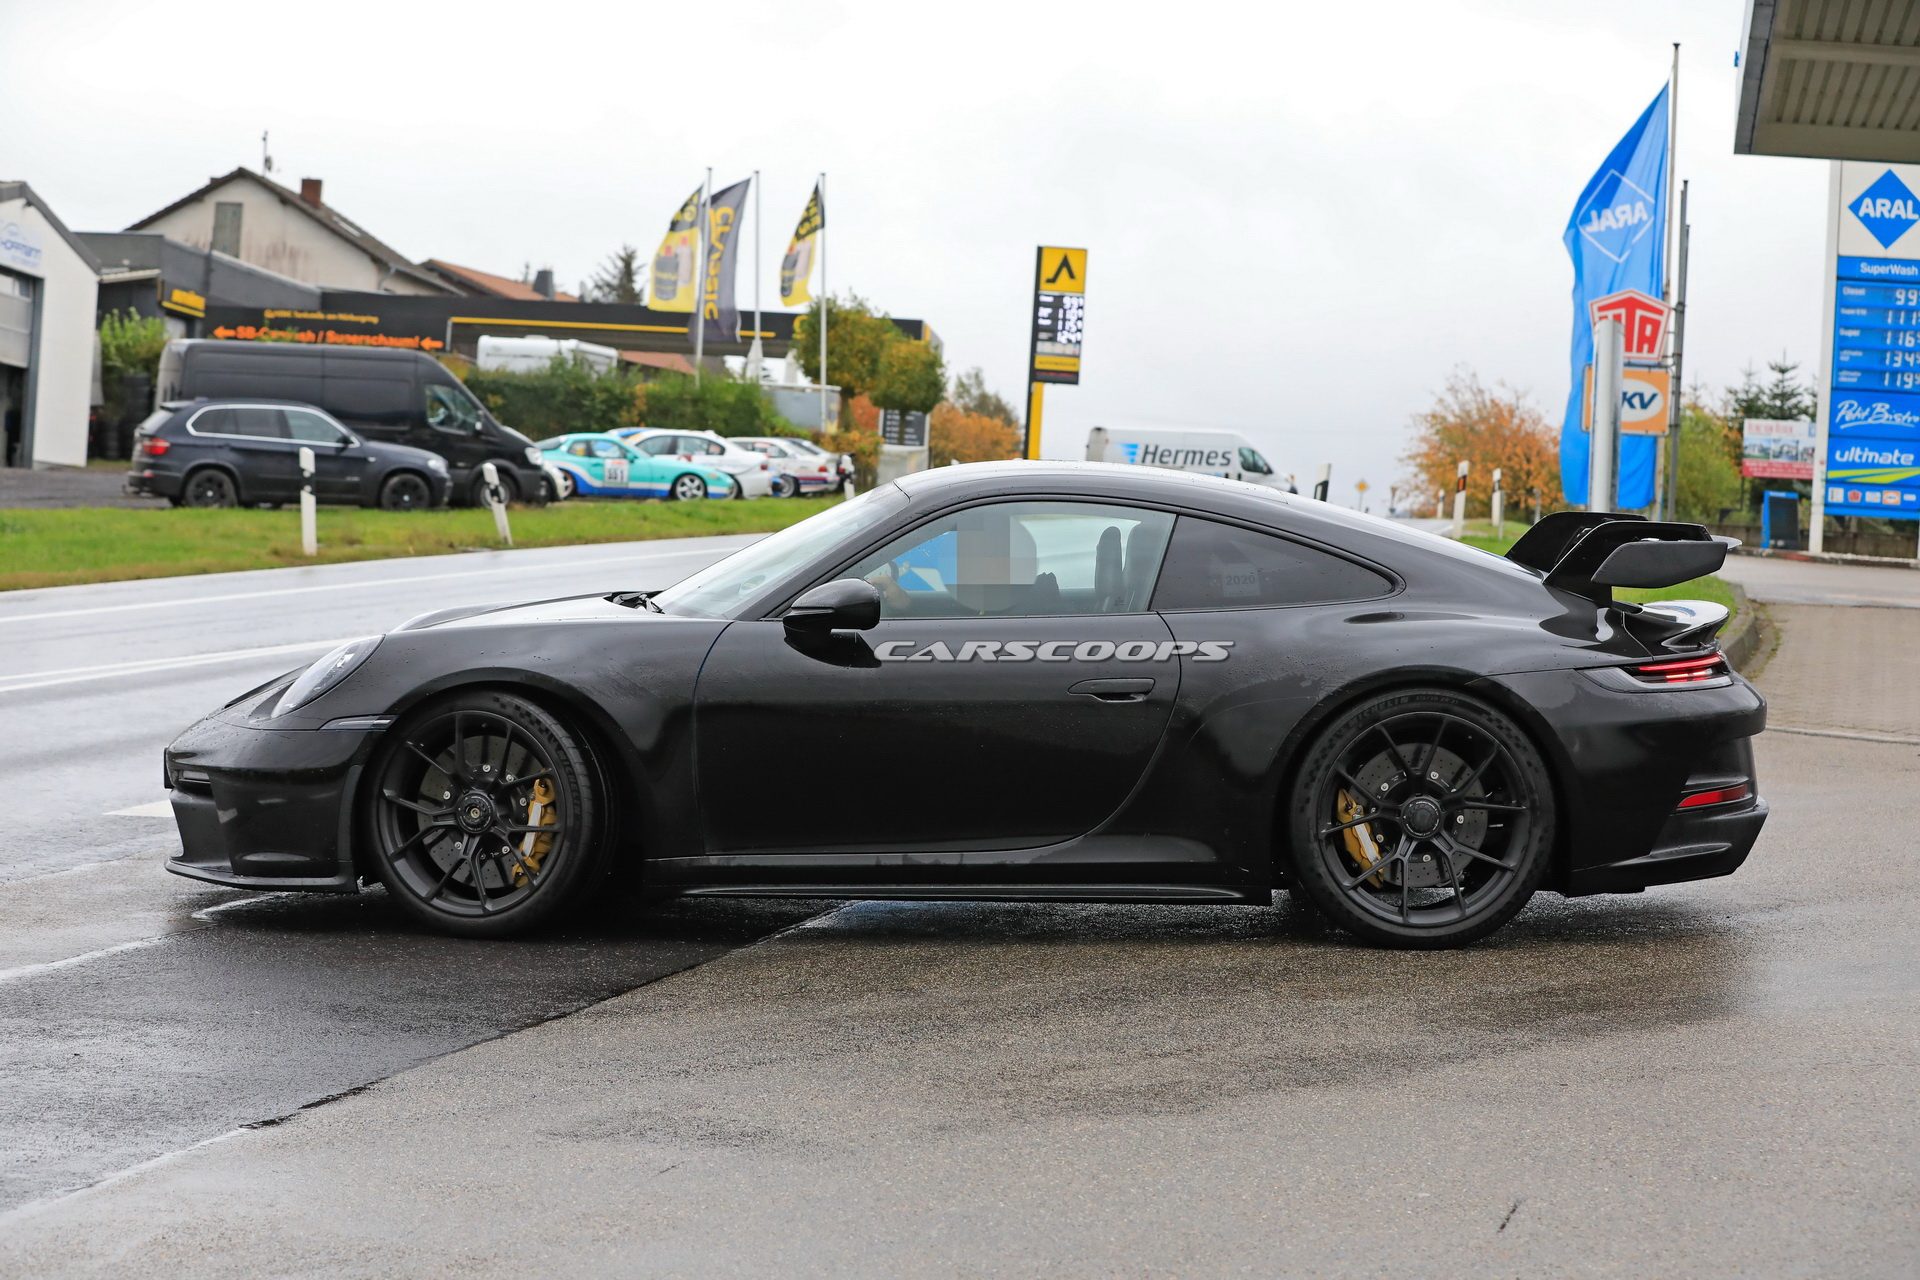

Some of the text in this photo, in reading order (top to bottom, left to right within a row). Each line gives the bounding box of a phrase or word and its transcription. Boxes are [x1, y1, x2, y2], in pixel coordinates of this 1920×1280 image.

[1858, 197, 1920, 220] ARAL
[1860, 262, 1919, 276] SuperWash
[1895, 288, 1920, 306] 99
[1621, 391, 1659, 410] KV
[1141, 444, 1232, 467] Hermes
[1835, 446, 1915, 466] ultimate
[1225, 575, 1256, 586] 2020
